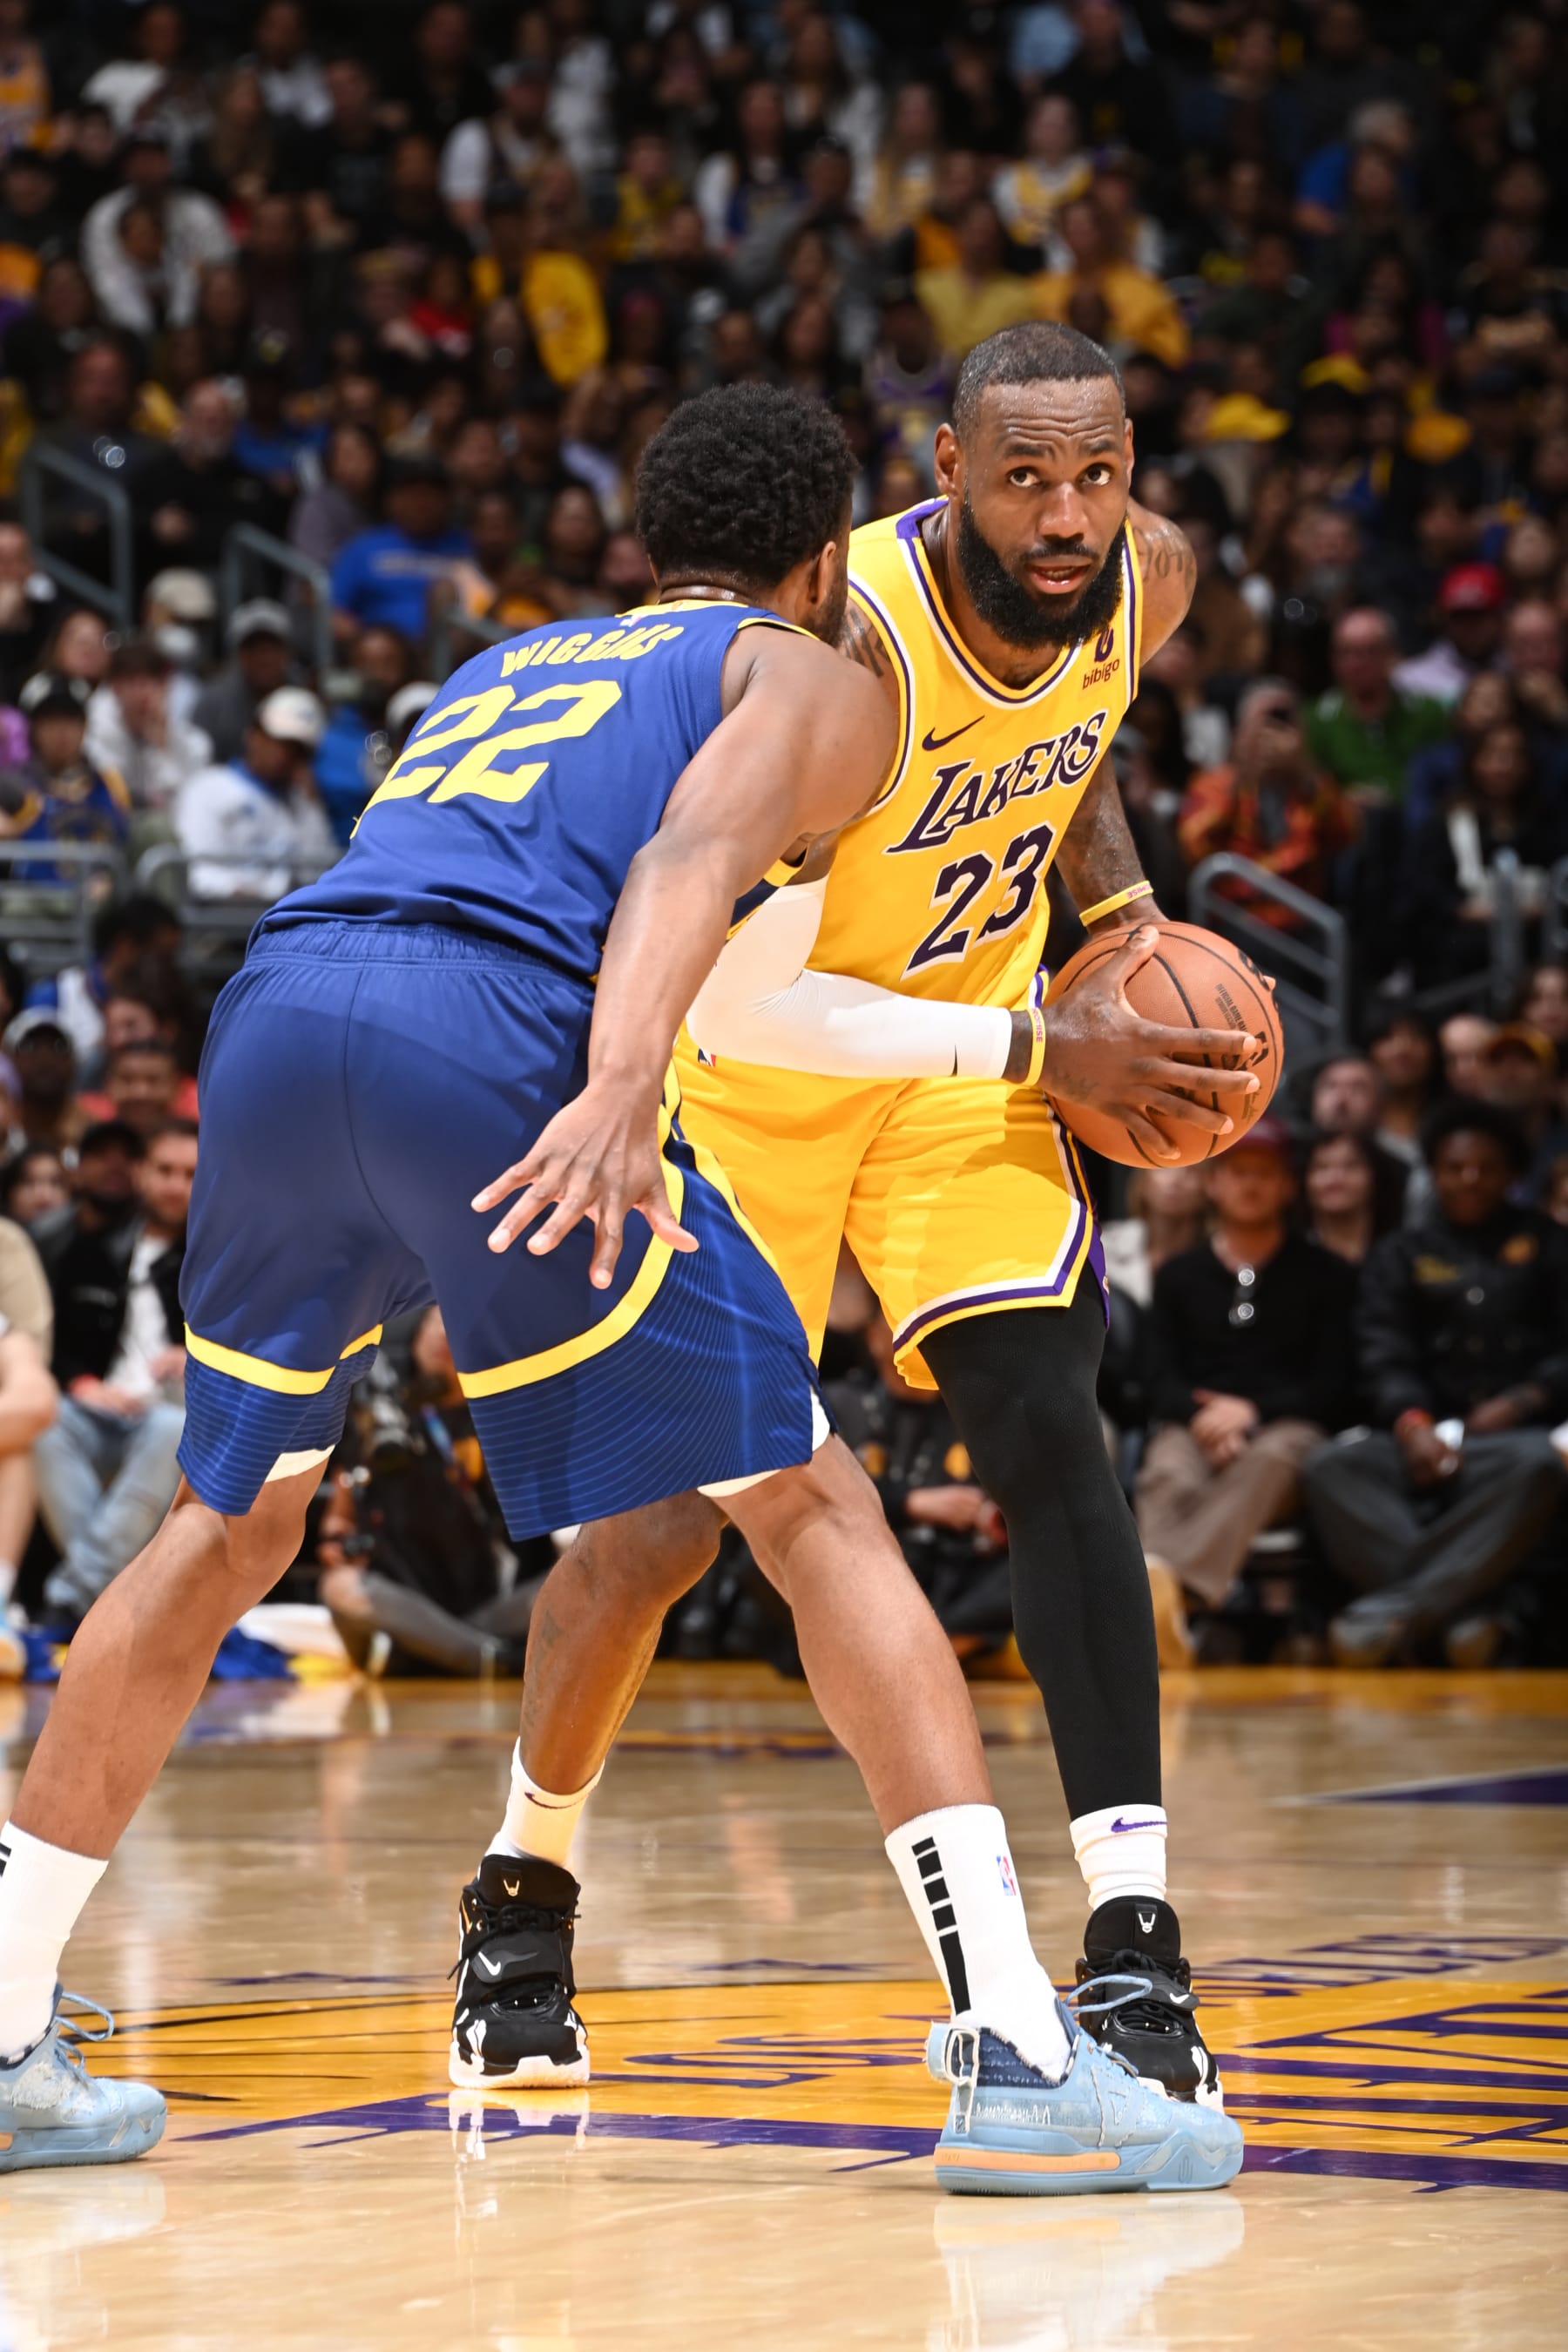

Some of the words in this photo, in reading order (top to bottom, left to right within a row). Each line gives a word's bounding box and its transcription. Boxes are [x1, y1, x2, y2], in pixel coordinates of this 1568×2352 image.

[1082, 659, 1120, 690] bibigo
[349, 679, 623, 840] 22
[882, 708, 1109, 855] LAKERS
[899, 820, 1058, 982] 23
